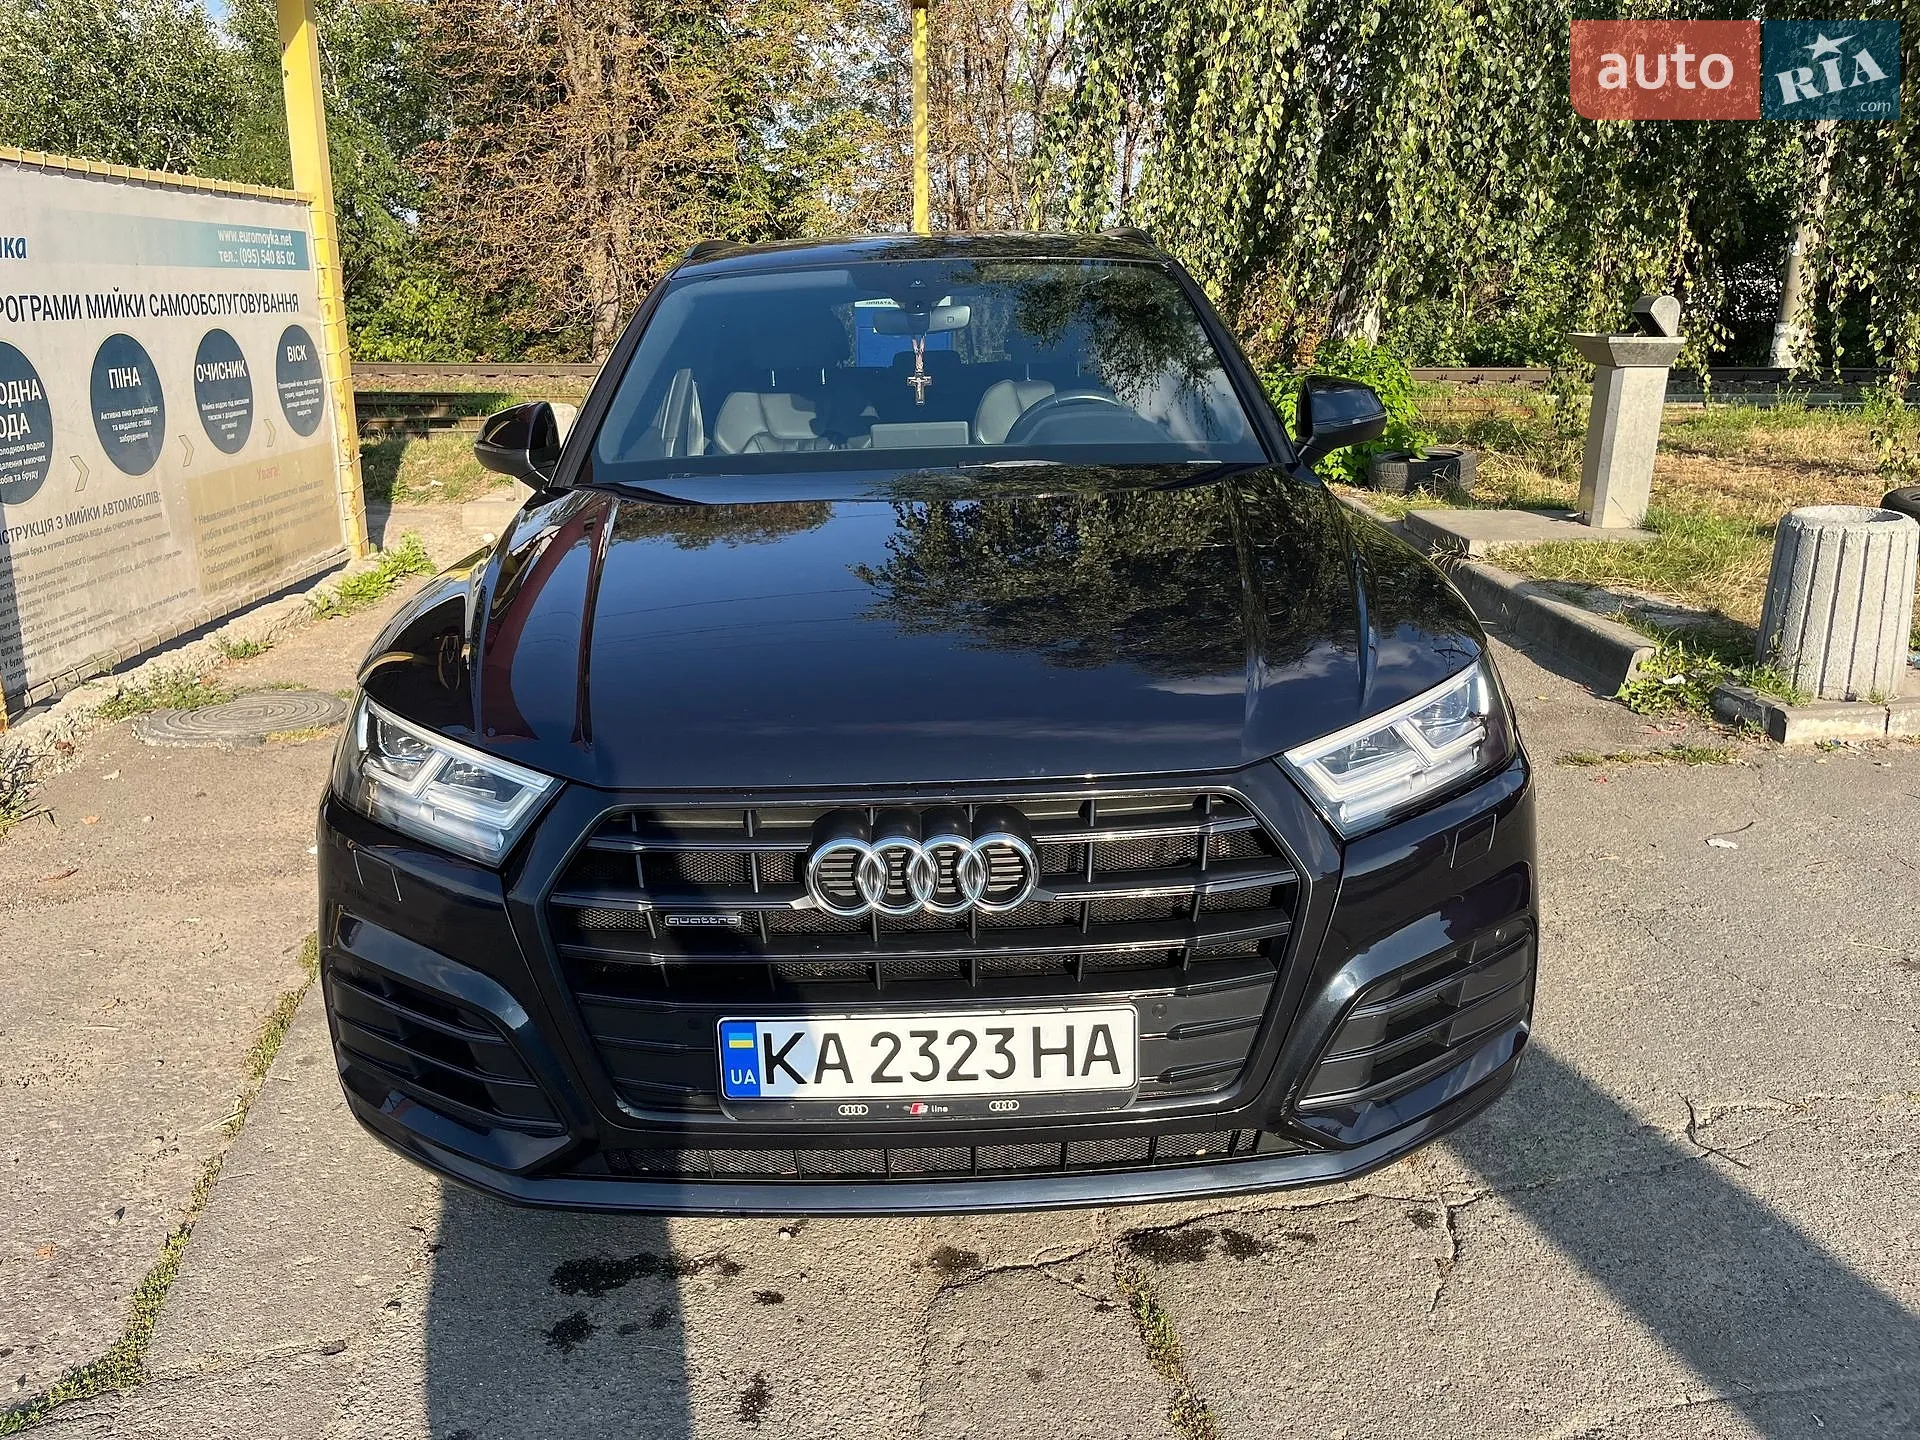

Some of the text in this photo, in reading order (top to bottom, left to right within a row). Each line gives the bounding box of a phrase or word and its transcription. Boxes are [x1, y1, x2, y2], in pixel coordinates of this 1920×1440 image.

[218, 229, 292, 248] www.euromoyka.net
[239, 248, 260, 267] (095)
[261, 251, 274, 264] 540
[276, 252, 286, 265] 85
[286, 252, 297, 266] 02
[85, 286, 146, 319] МИЙКИ
[149, 292, 299, 318] САМООБСЛУГОВУВАННЯ
[287, 345, 308, 362] ВІСК
[108, 366, 142, 389] ПІНА
[196, 360, 247, 383] ОЧИСНИК
[14, 473, 22, 482] та
[56, 515, 64, 530] З
[65, 507, 101, 528] МИЙКИ
[103, 490, 163, 518] АВТОМОБІЛІВ:
[668, 916, 738, 926] quattro
[762, 1023, 1122, 1086] KA 2323 HA
[730, 1068, 757, 1086] UA
[931, 1104, 949, 1113] line
